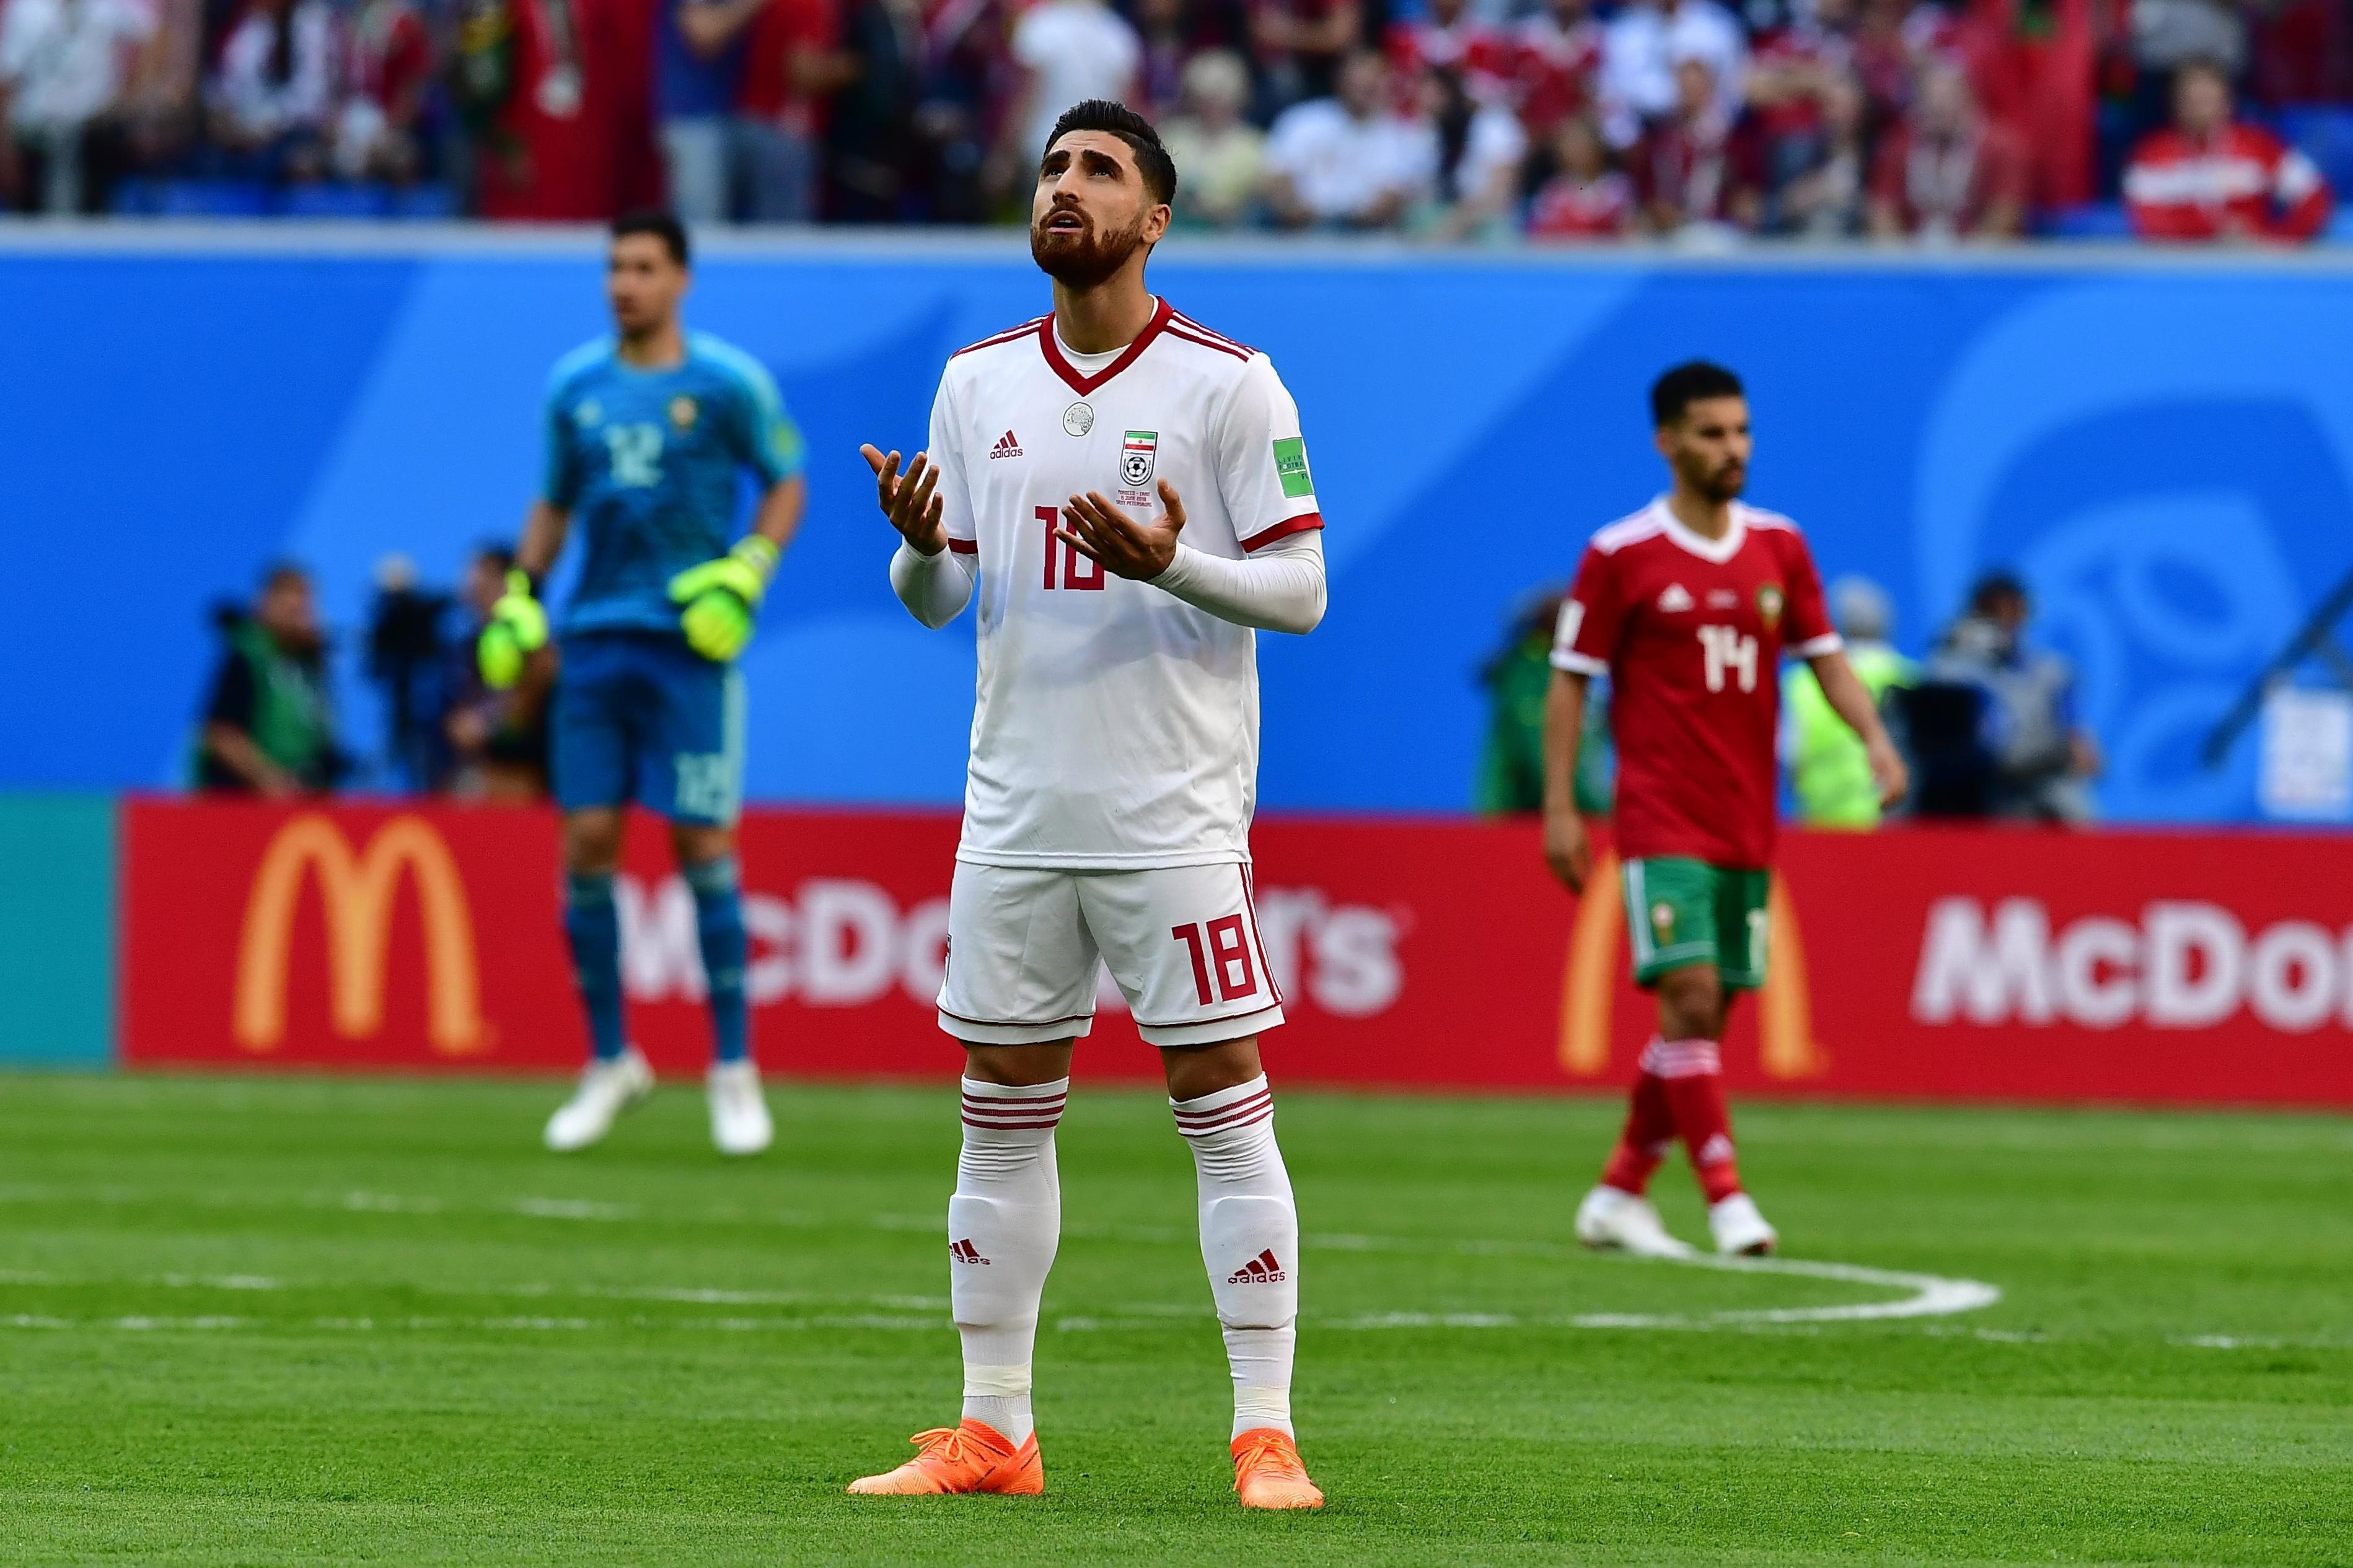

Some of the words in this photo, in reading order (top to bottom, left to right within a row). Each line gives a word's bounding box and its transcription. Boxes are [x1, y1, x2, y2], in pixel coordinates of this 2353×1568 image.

[990, 447, 1023, 459] adidas
[1696, 624, 1759, 694] 14
[1171, 913, 1257, 1005] 18
[1911, 896, 2353, 1031] McDo
[1228, 1271, 1286, 1284] adidas
